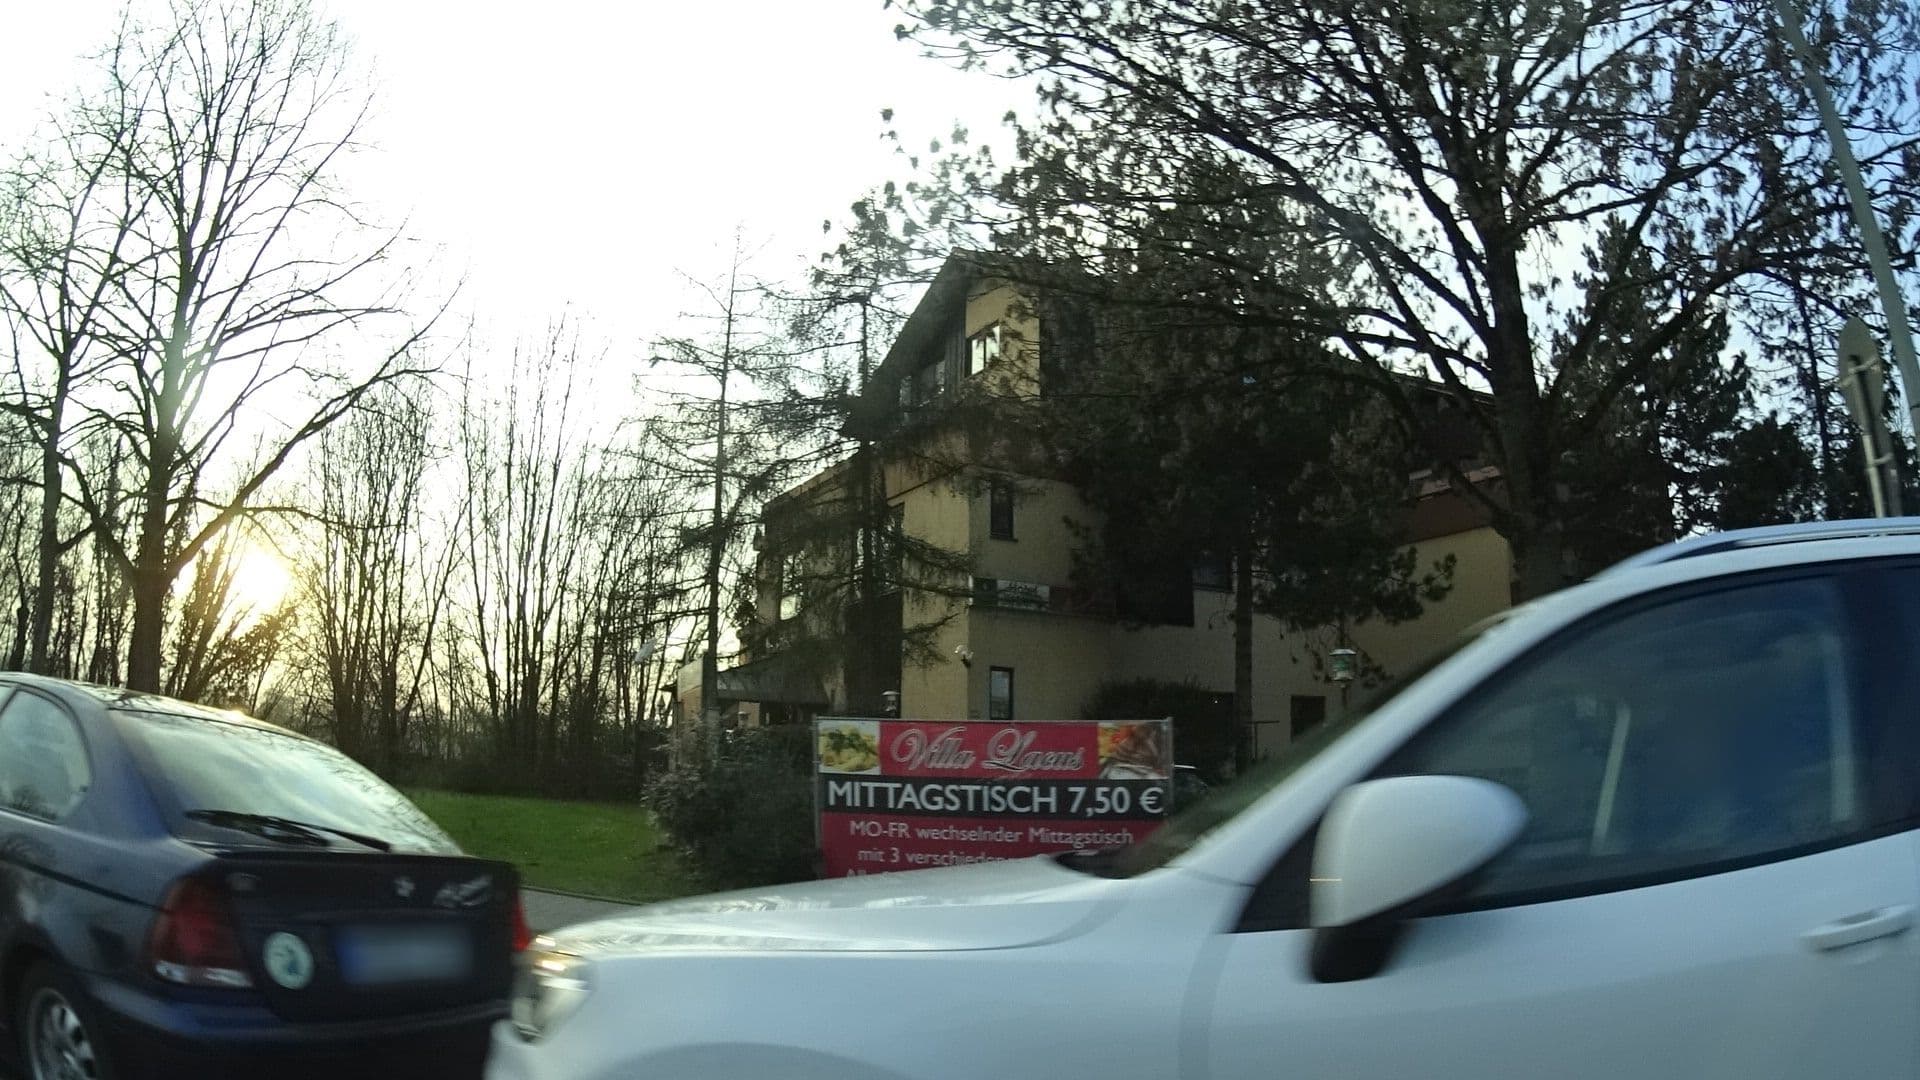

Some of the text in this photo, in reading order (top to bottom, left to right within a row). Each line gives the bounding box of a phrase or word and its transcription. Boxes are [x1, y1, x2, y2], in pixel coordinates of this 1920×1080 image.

[890, 726, 1084, 773] Villa Lacus
[827, 780, 1165, 817] MITTAGSTISCH 7,50 €
[849, 821, 1134, 849] MO-FR wechselnder Mittagstisch
[857, 847, 885, 861] mit
[890, 848, 900, 862] 3
